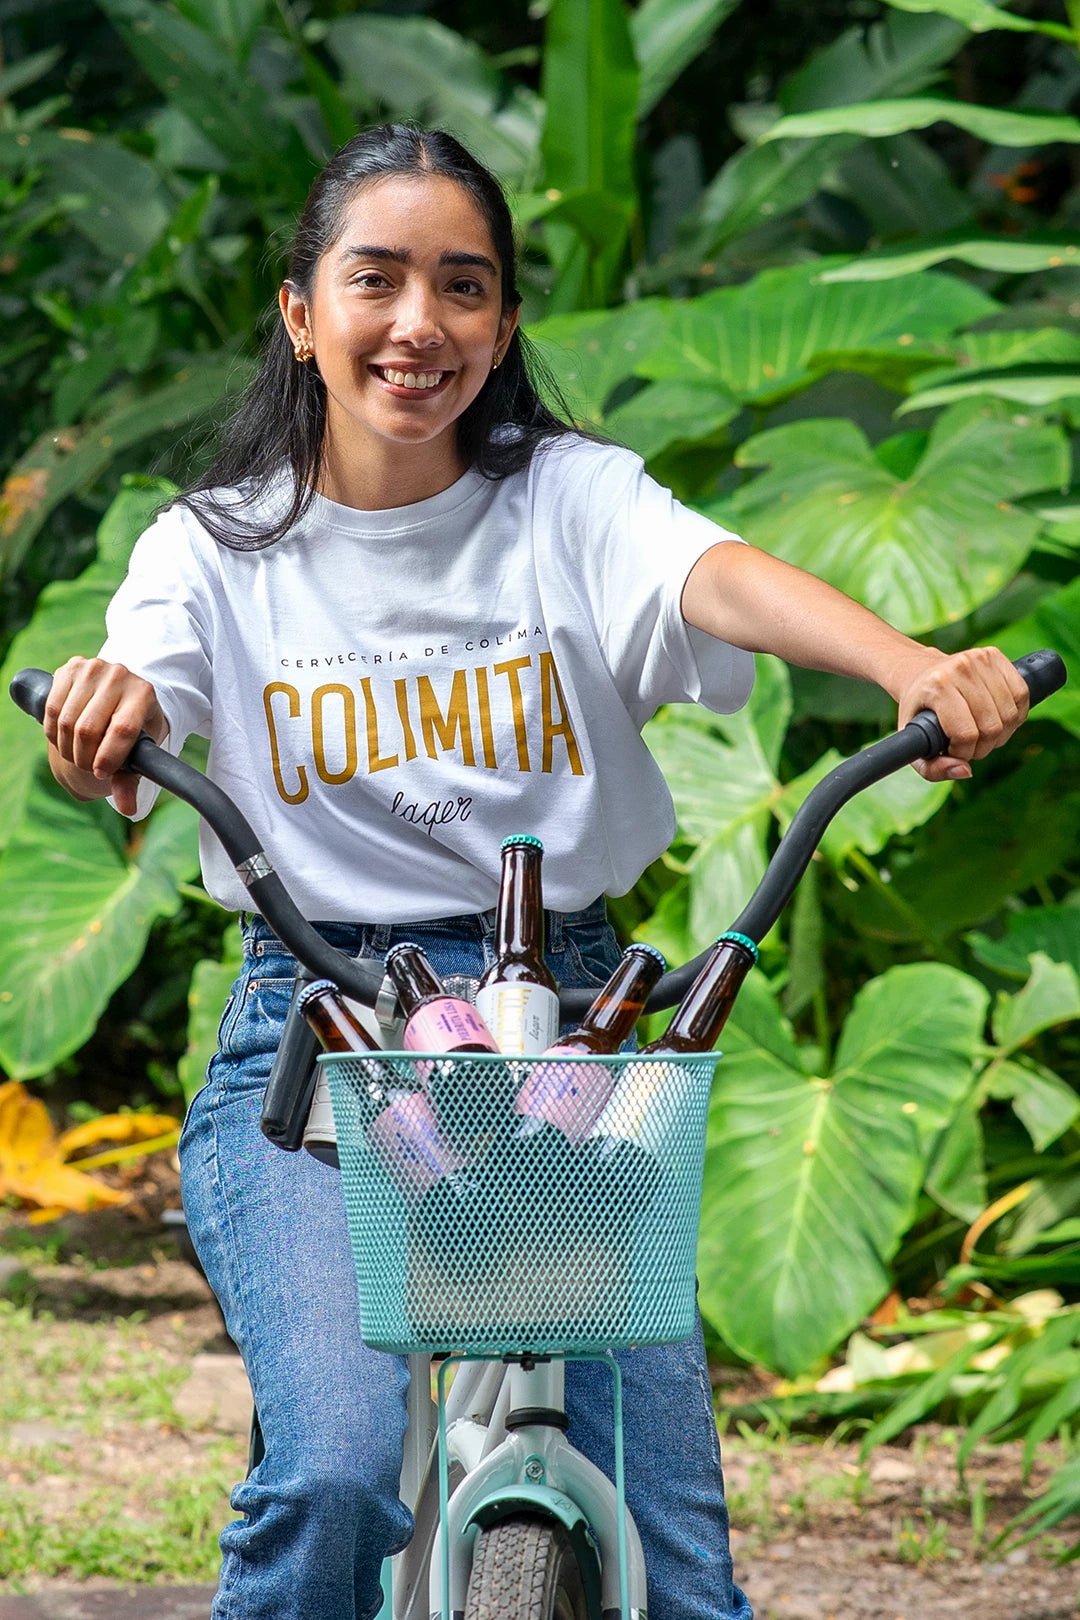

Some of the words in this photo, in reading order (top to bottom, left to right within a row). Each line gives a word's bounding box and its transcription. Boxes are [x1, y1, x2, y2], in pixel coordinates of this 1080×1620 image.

[281, 650, 409, 668] CERVECERÍA
[424, 645, 449, 657] DE
[464, 626, 543, 651] COLIMA
[263, 651, 584, 805] COLIMITA
[391, 790, 472, 837] lager
